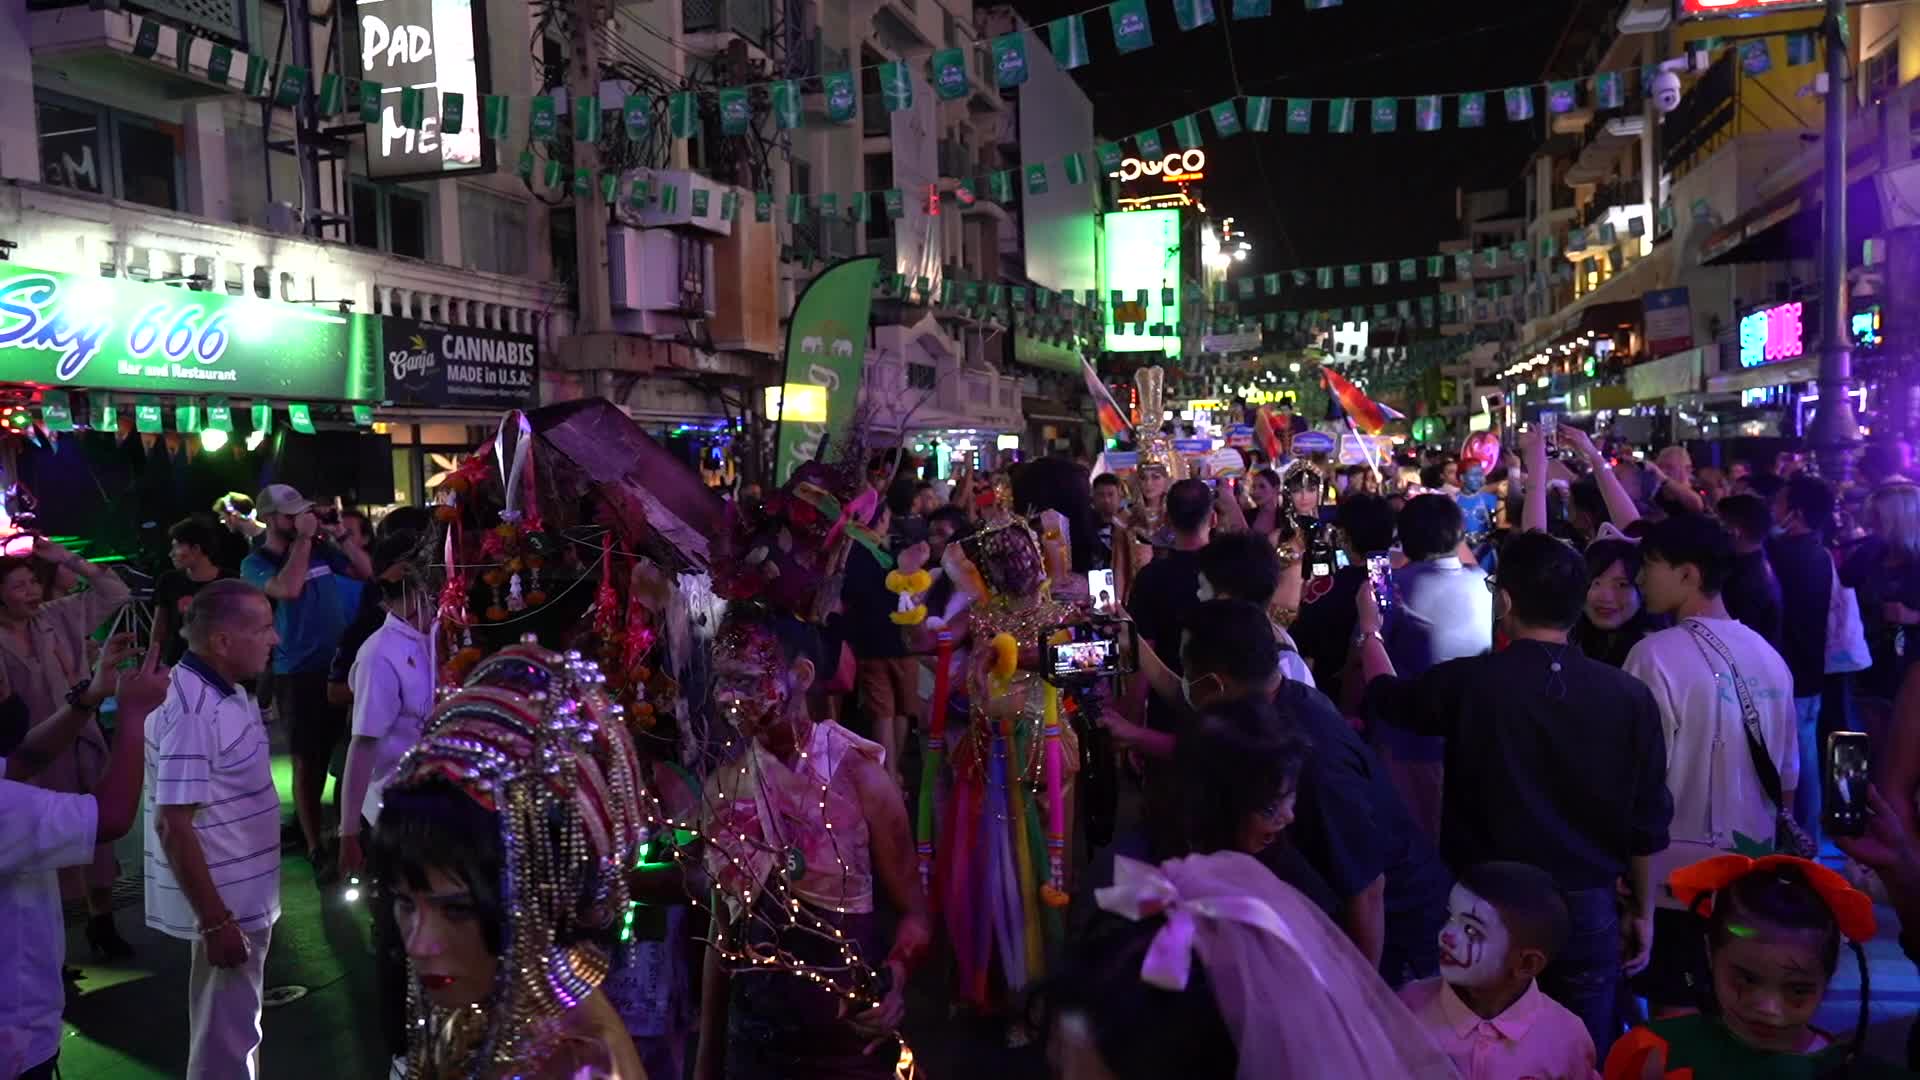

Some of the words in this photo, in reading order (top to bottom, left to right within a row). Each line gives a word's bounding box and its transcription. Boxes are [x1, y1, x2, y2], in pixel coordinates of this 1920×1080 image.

[362, 15, 432, 71] PAD
[382, 106, 438, 157] ME
[0, 274, 109, 380] Sky
[128, 301, 230, 364] 666
[389, 350, 436, 380] Ganja
[442, 334, 534, 367] CANNABIS
[118, 360, 141, 376] Bar
[143, 363, 169, 378] and
[172, 363, 236, 381] Restaurant
[448, 365, 483, 384] MADE
[485, 367, 497, 385] in
